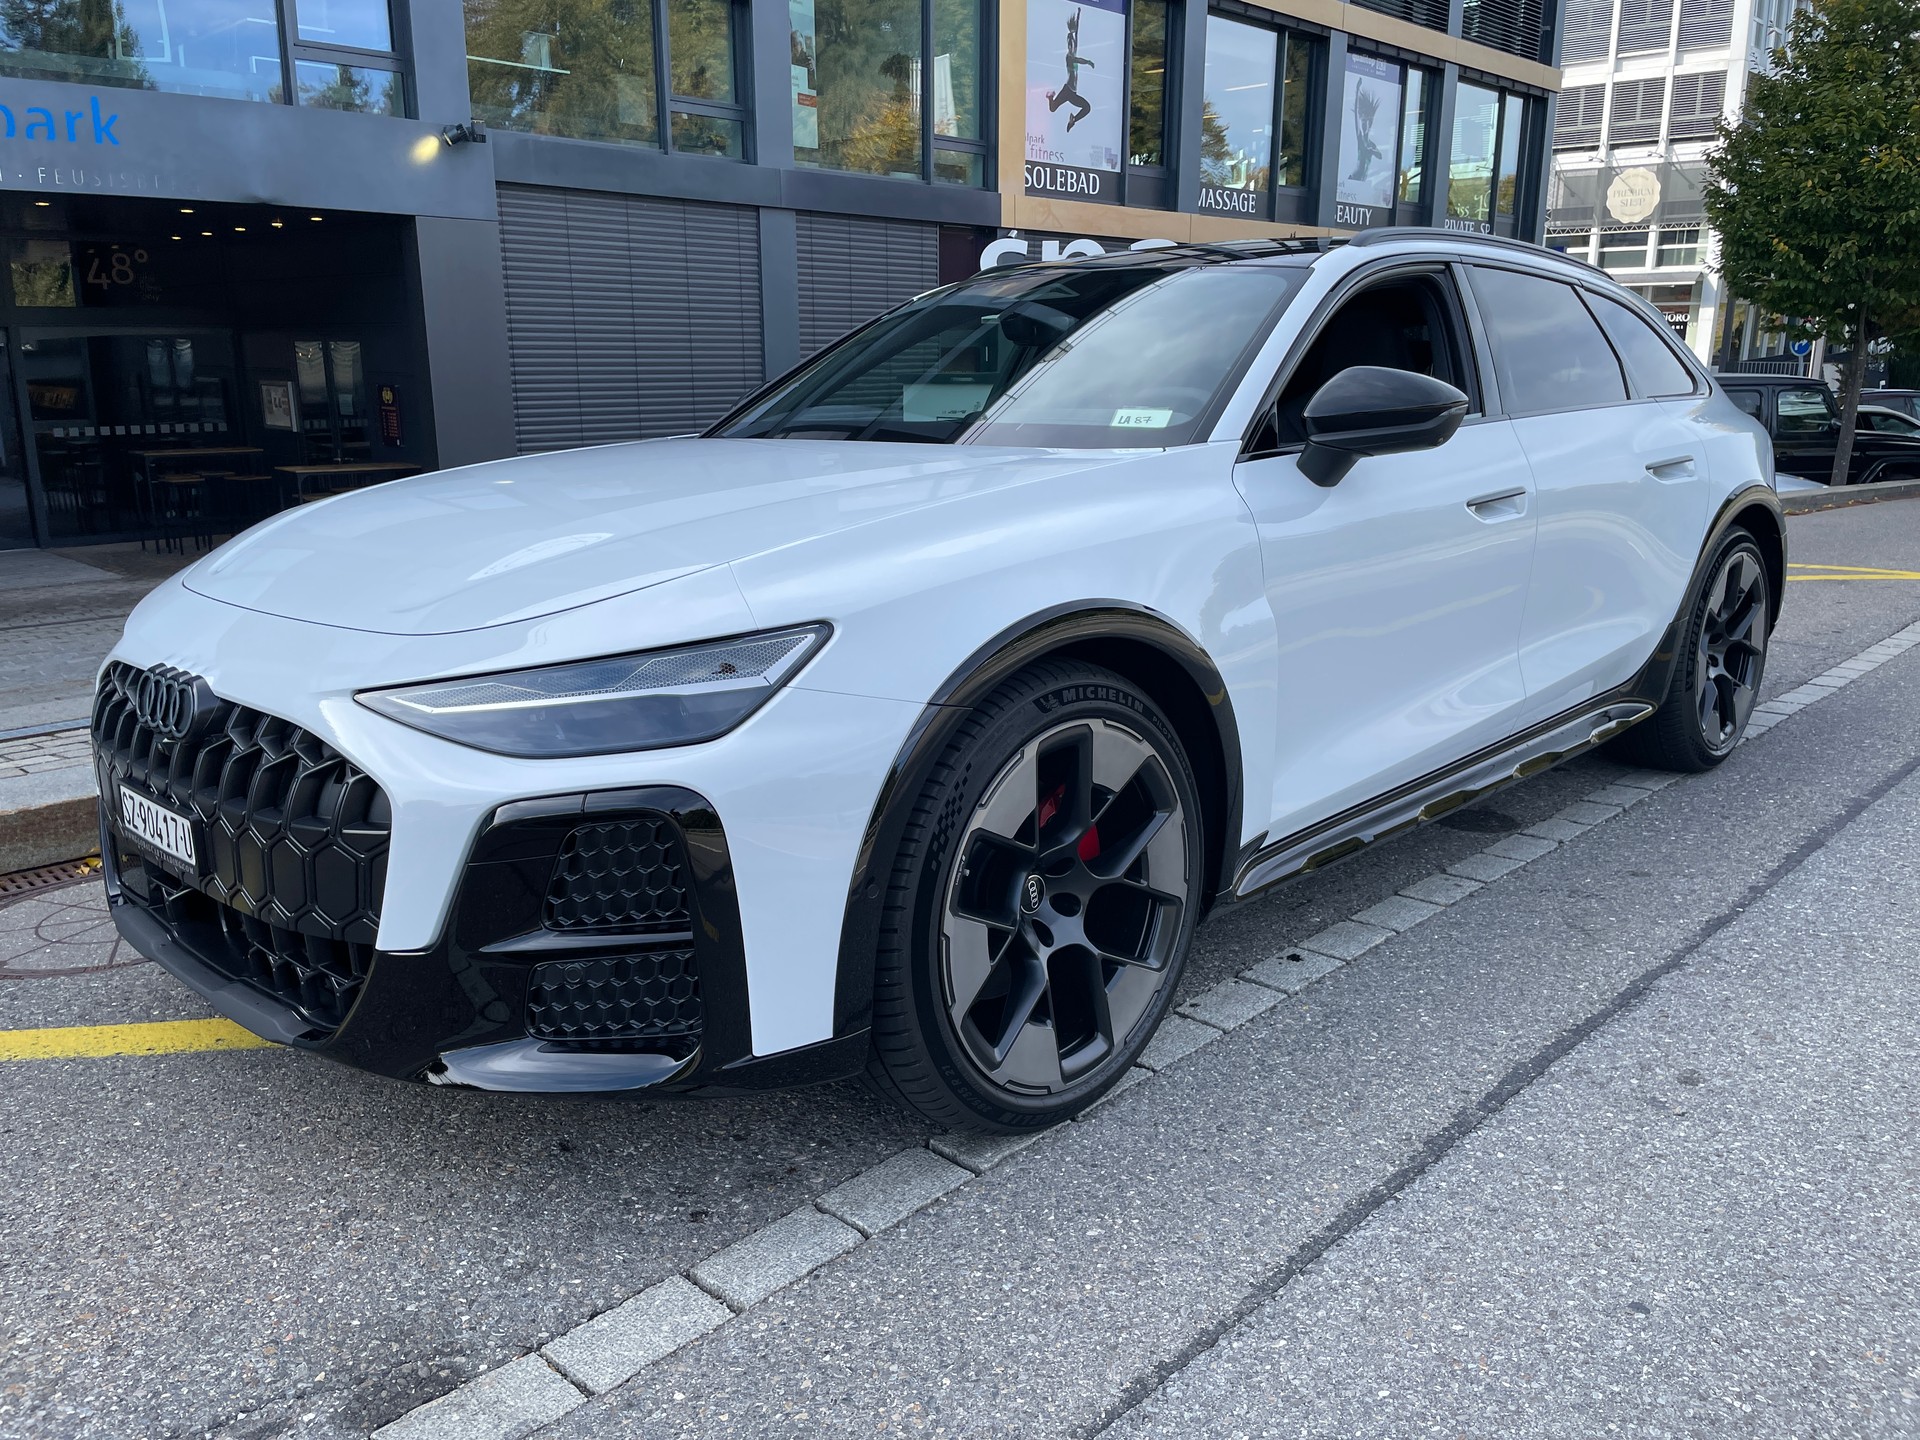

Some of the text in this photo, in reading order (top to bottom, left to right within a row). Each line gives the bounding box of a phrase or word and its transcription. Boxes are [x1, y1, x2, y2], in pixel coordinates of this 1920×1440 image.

[1030, 144, 1065, 163] fitness
[1025, 164, 1100, 195] SOLEBAD
[1198, 187, 1257, 213] MASSAGE
[1613, 188, 1655, 198] PREMIUM
[1620, 198, 1646, 207] SHOP
[1335, 204, 1373, 225] EAUTY
[980, 238, 1179, 271] sp
[1062, 686, 1143, 713] MICHELIN
